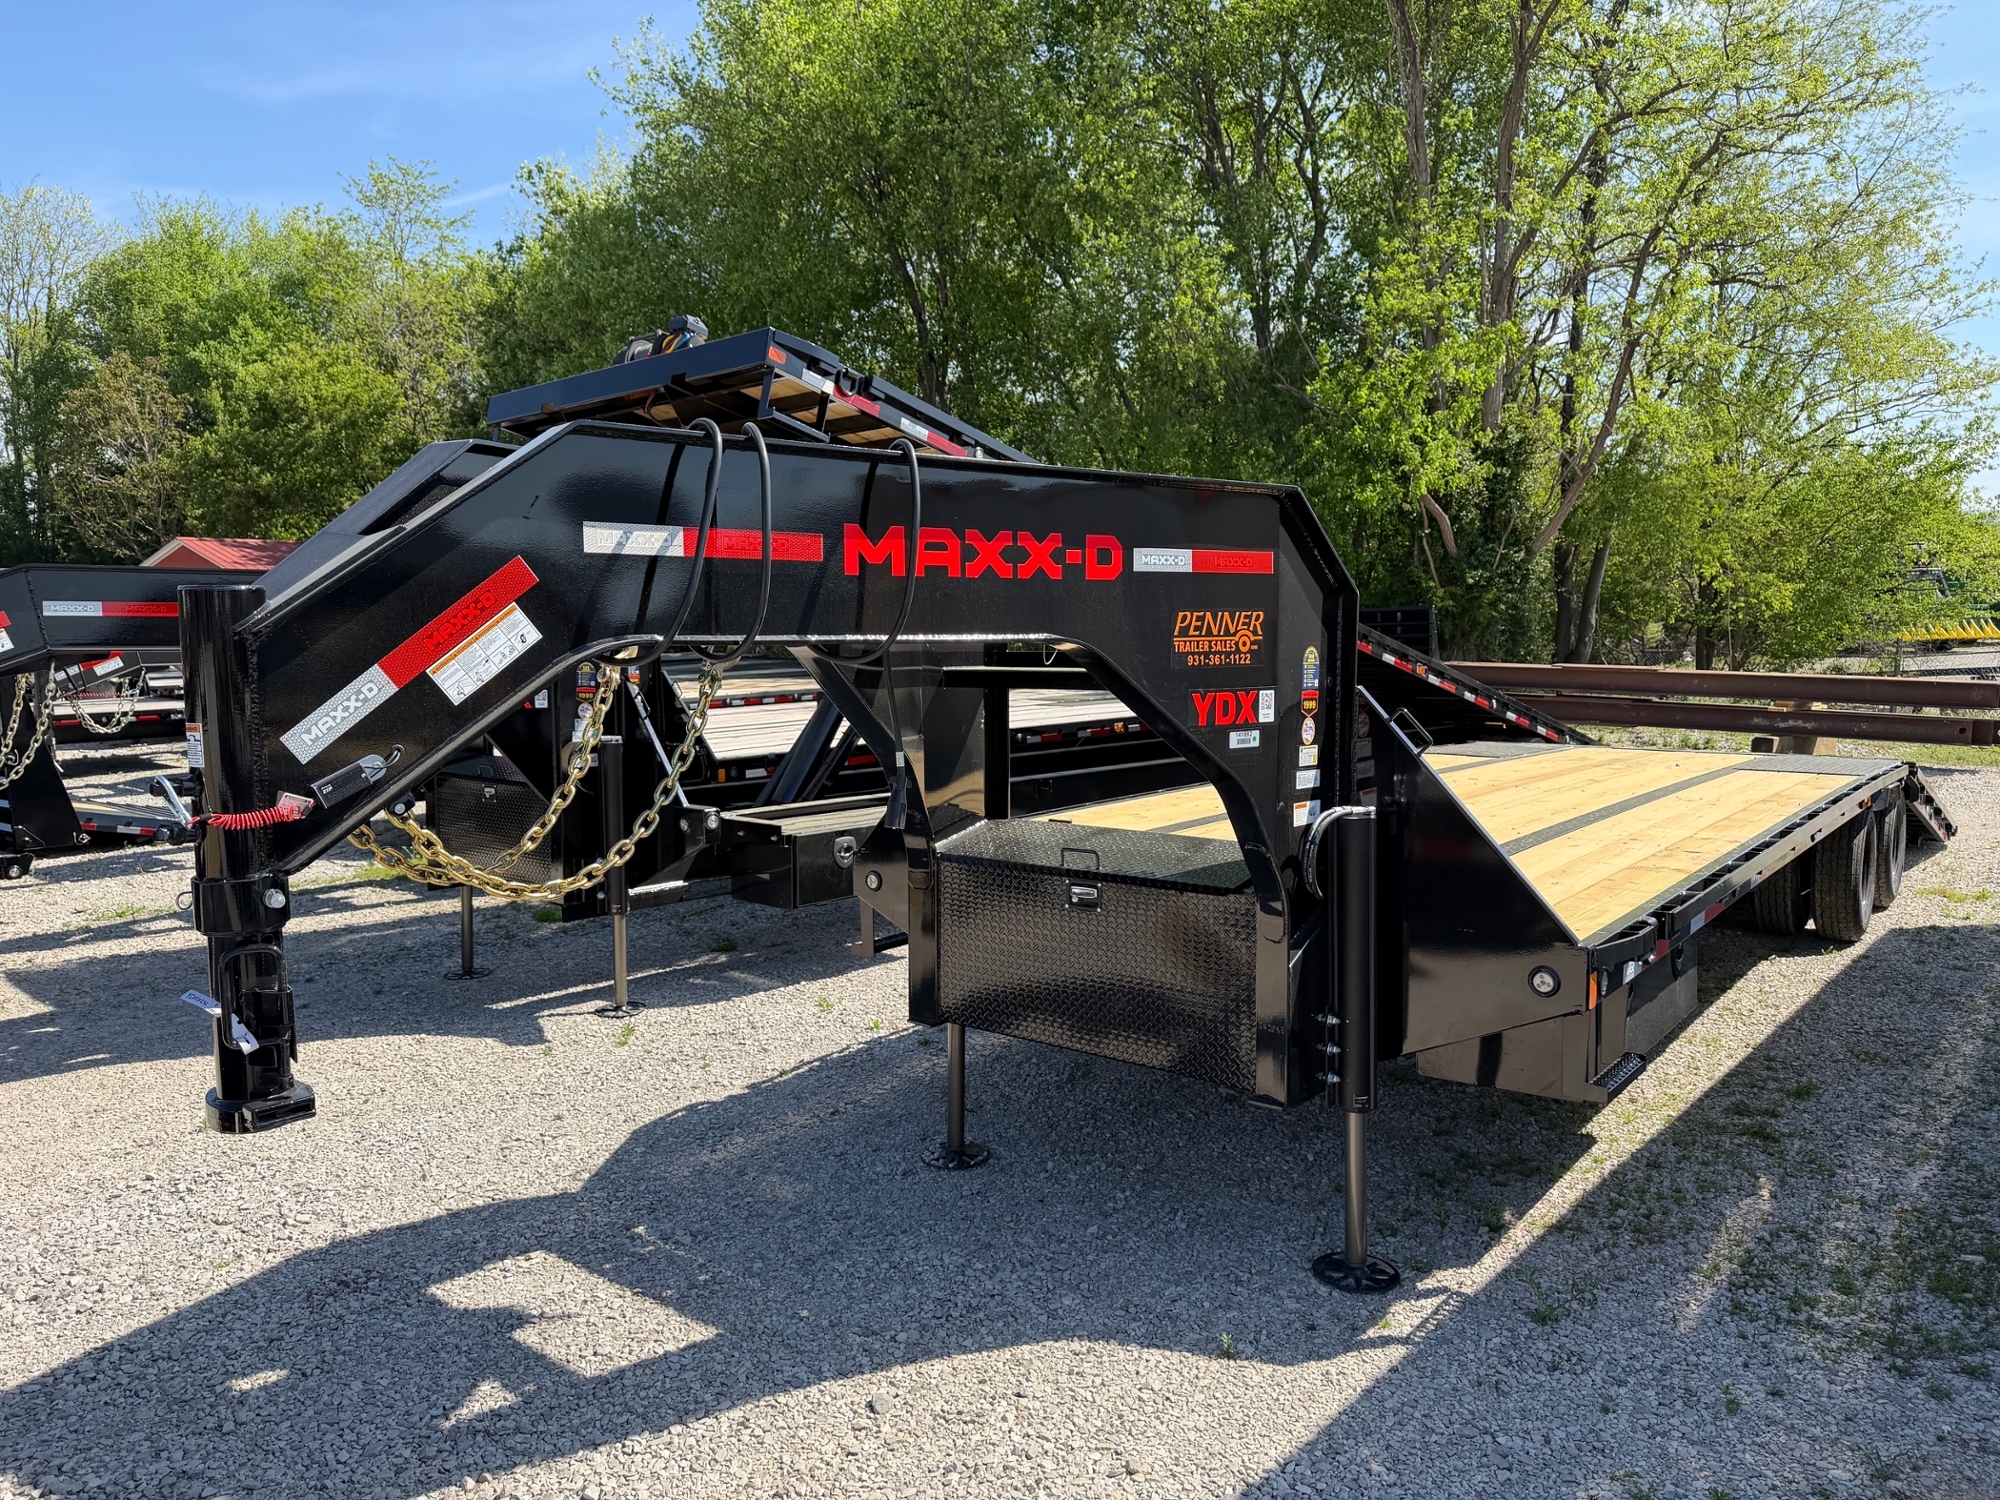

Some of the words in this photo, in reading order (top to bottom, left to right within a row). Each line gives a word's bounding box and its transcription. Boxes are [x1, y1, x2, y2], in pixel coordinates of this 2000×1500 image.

[597, 530, 672, 547] MAXX-D
[723, 536, 789, 552] MAX-D
[843, 522, 1123, 581] MAXX-D
[1140, 554, 1186, 566] MAXX-D
[1214, 556, 1253, 567] MAXX-D
[50, 604, 95, 613] MAXX-D
[125, 605, 168, 613] MAXX-D
[423, 590, 497, 651] MAXX-D
[1173, 611, 1265, 637] PENNER
[1173, 641, 1210, 653] TRAILER
[1211, 640, 1236, 652] SALES
[1187, 653, 1251, 666] 931-361-1122
[300, 681, 380, 747] MAXX-D
[1191, 690, 1259, 726] YDX
